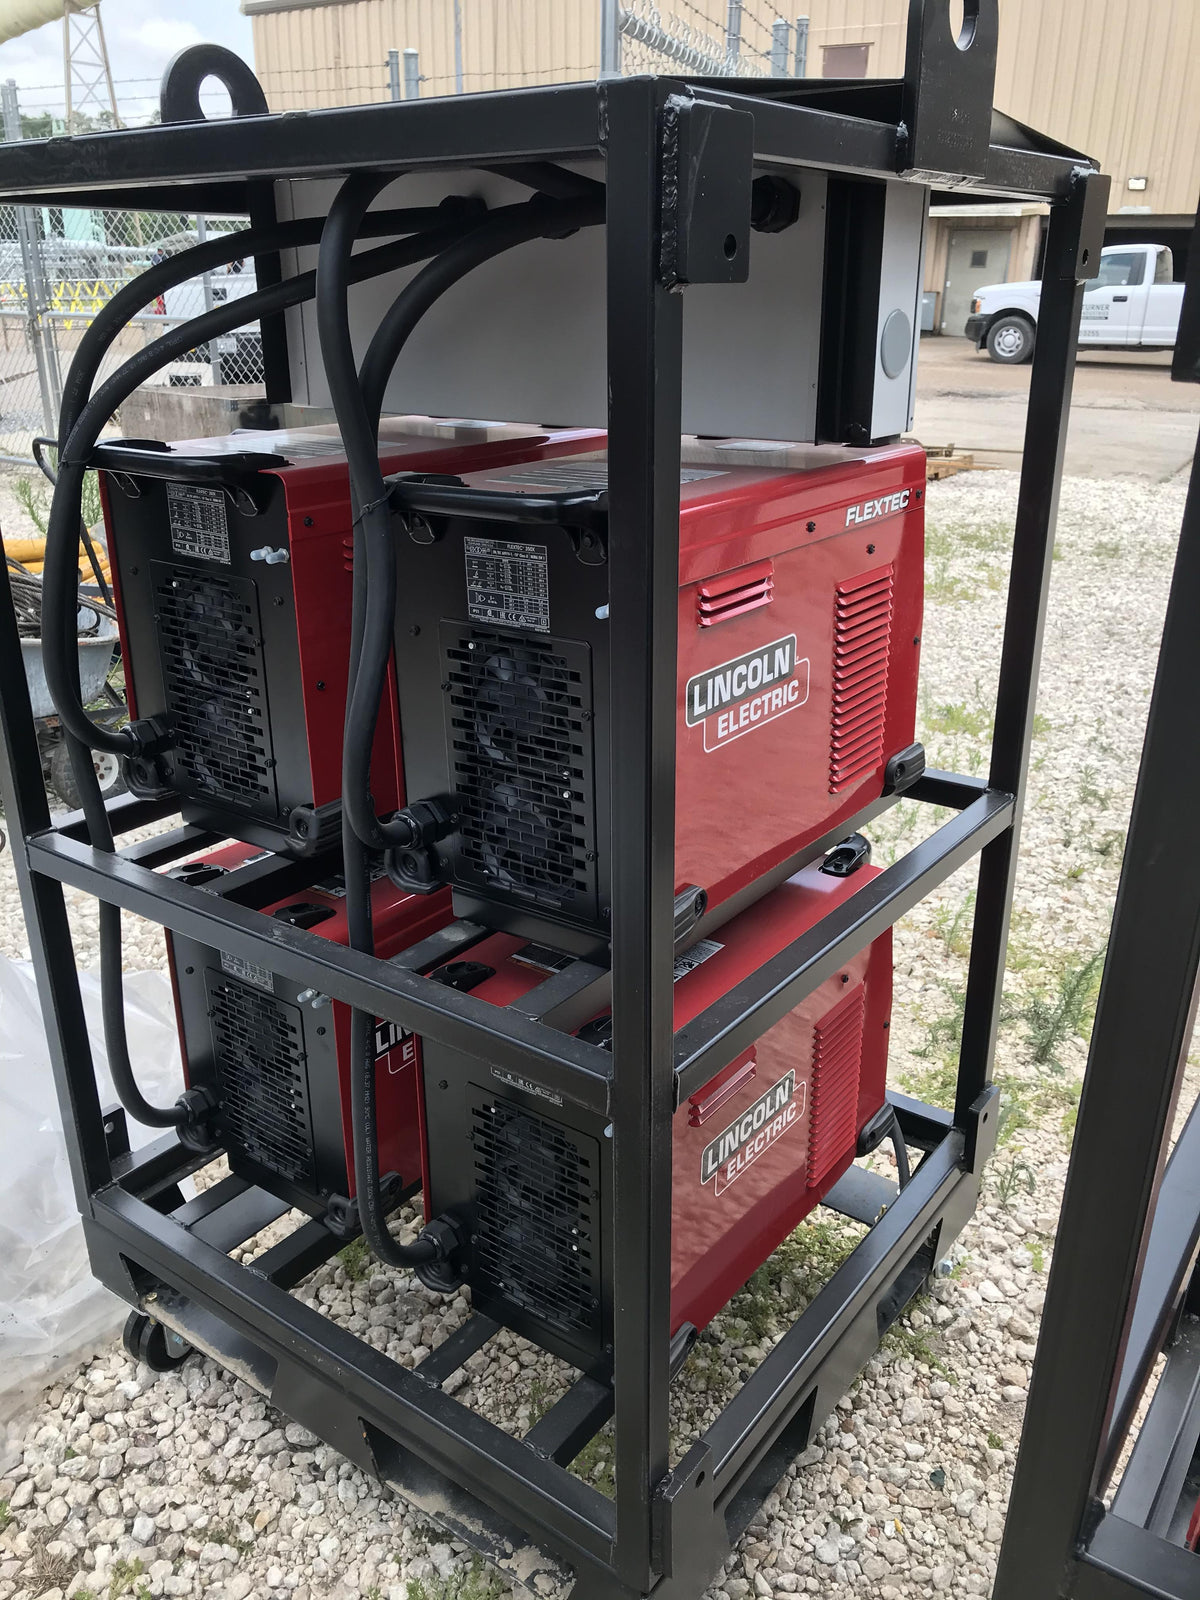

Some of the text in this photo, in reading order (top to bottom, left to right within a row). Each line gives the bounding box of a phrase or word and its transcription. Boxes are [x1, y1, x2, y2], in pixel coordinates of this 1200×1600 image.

[845, 489, 910, 527] FLEXTEC
[693, 644, 790, 717] LINCOLN
[717, 679, 799, 739] ELECTRIC
[707, 1079, 790, 1175] LINCOLN
[726, 1101, 797, 1181] ELECTRIC
